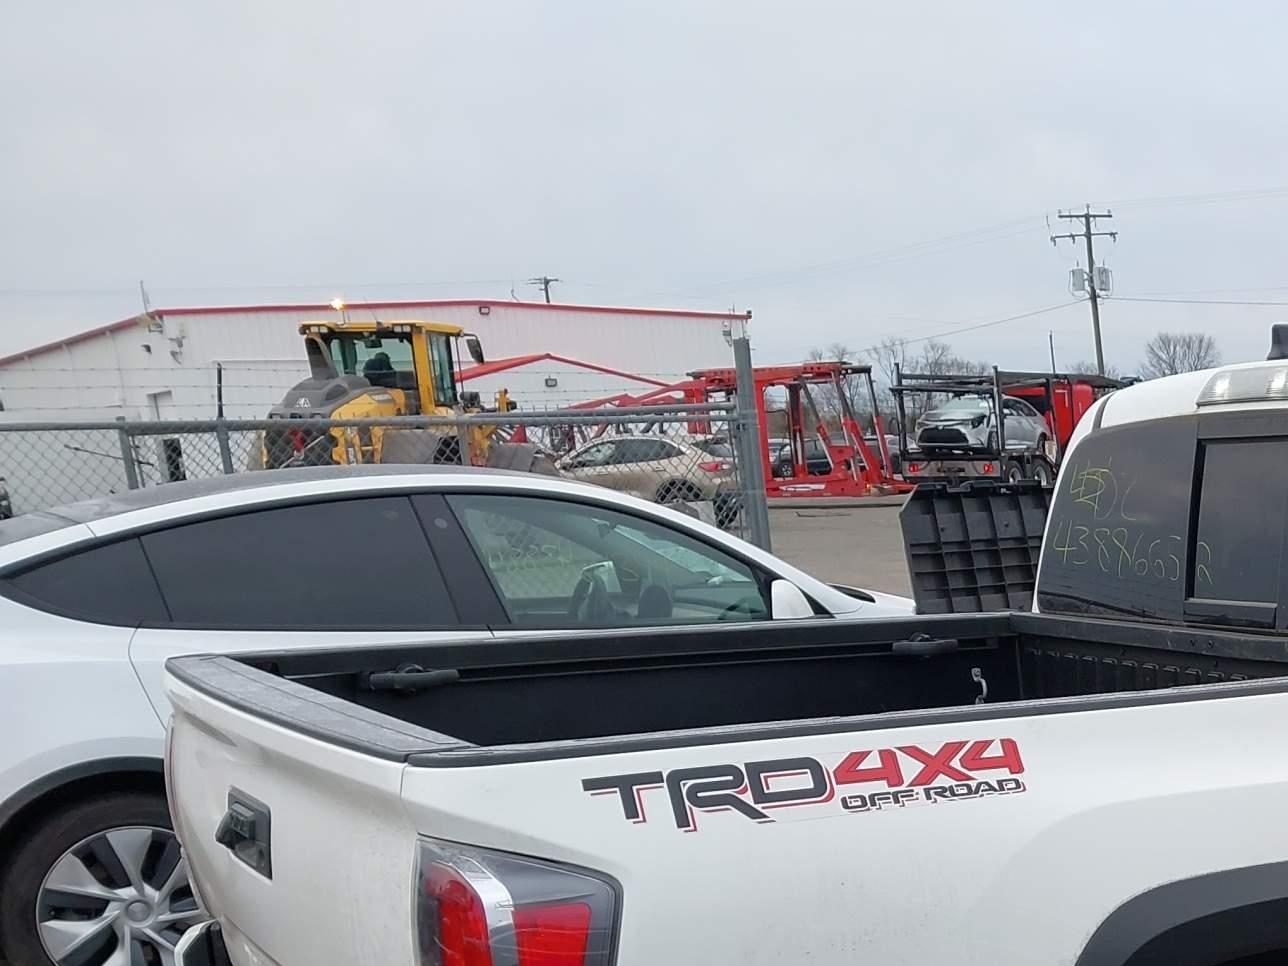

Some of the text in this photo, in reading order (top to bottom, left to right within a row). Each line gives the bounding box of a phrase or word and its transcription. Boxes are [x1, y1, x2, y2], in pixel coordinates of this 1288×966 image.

[581, 737, 1025, 834] TRD 4X4
[840, 777, 1027, 812] OFF ROAD
